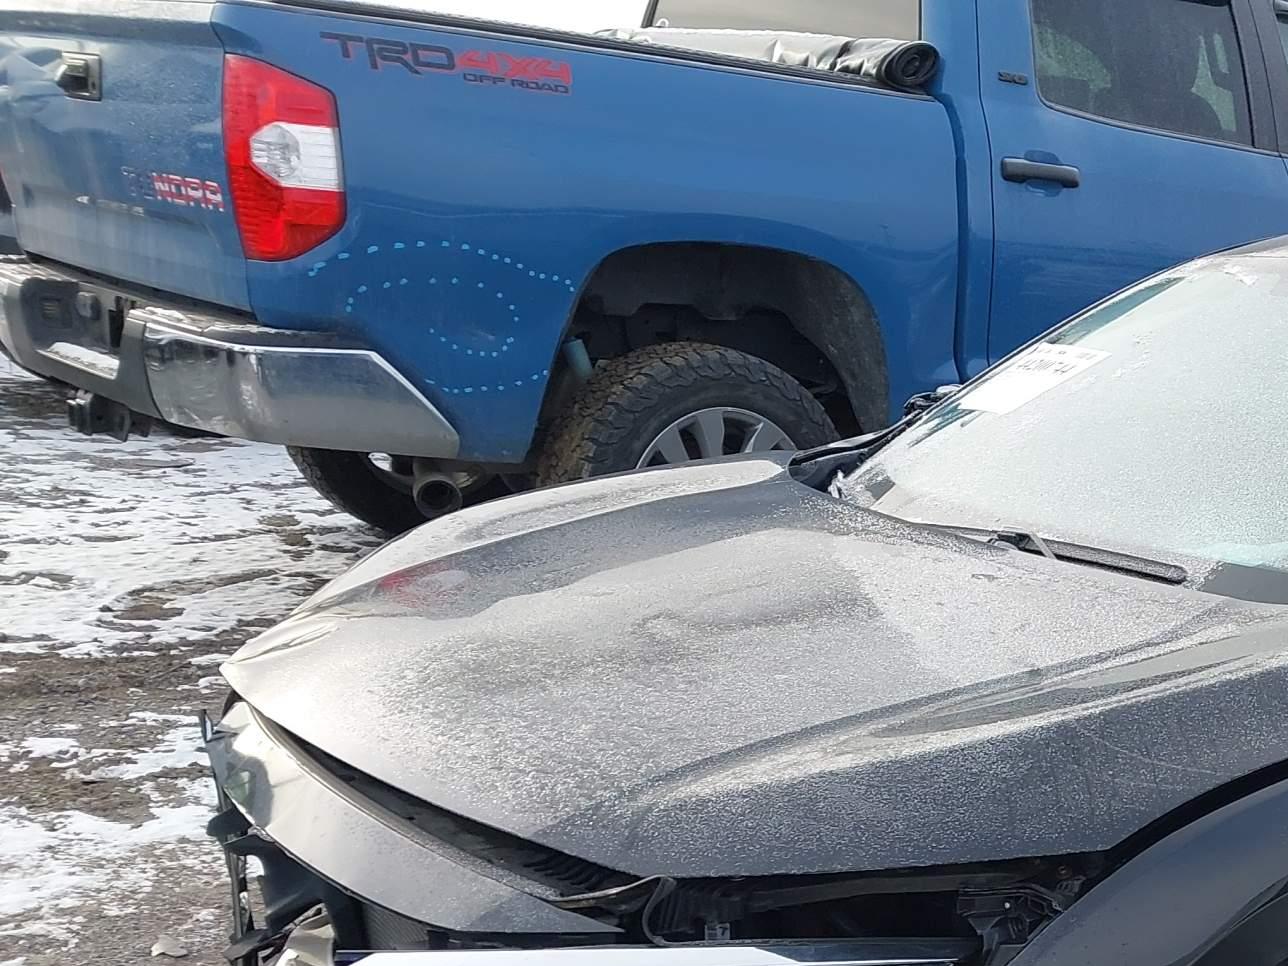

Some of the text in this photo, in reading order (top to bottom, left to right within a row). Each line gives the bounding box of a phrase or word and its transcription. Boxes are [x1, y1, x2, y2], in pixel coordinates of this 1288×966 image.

[320, 31, 456, 75] TRD
[462, 72, 570, 95] OFF ROAD
